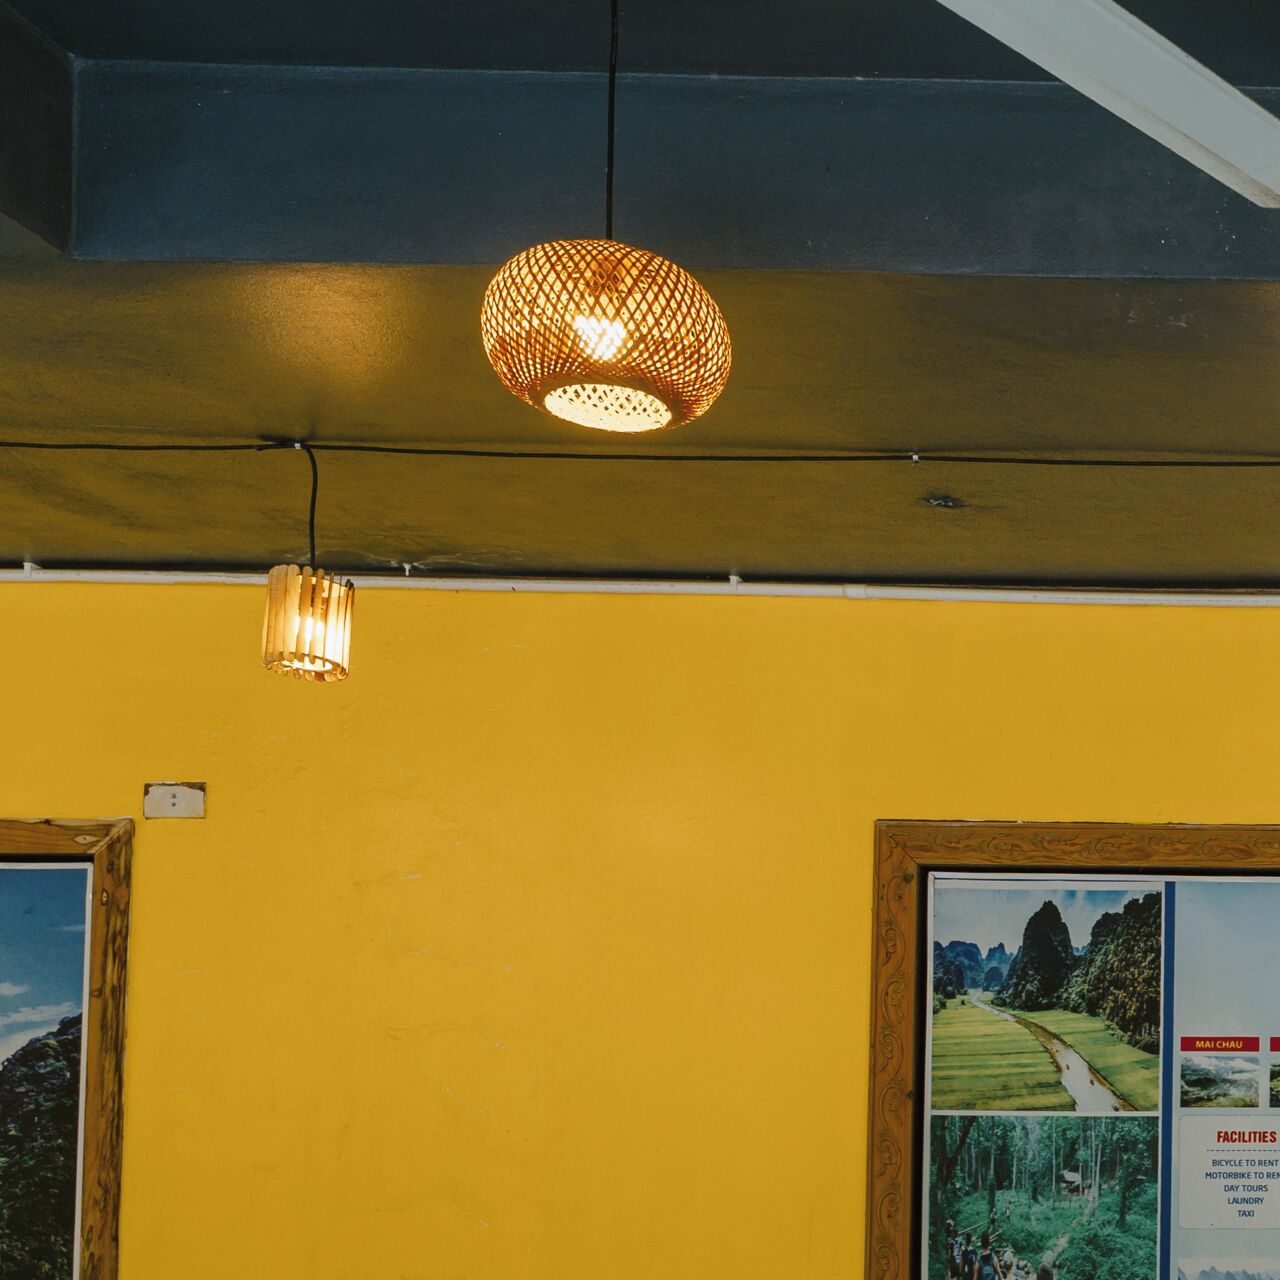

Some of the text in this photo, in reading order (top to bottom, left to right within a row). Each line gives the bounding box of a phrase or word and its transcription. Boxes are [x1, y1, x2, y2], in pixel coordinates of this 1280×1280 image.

[1195, 1040, 1243, 1049] MAI CHAU
[1217, 1130, 1277, 1143] FACILITIES
[1212, 1159, 1279, 1167] BICYCLE TO RENT
[1205, 1171, 1251, 1180] MOTORBIKE
[1223, 1184, 1269, 1192] DAY TOURS
[1227, 1197, 1264, 1205] LAUNDRY
